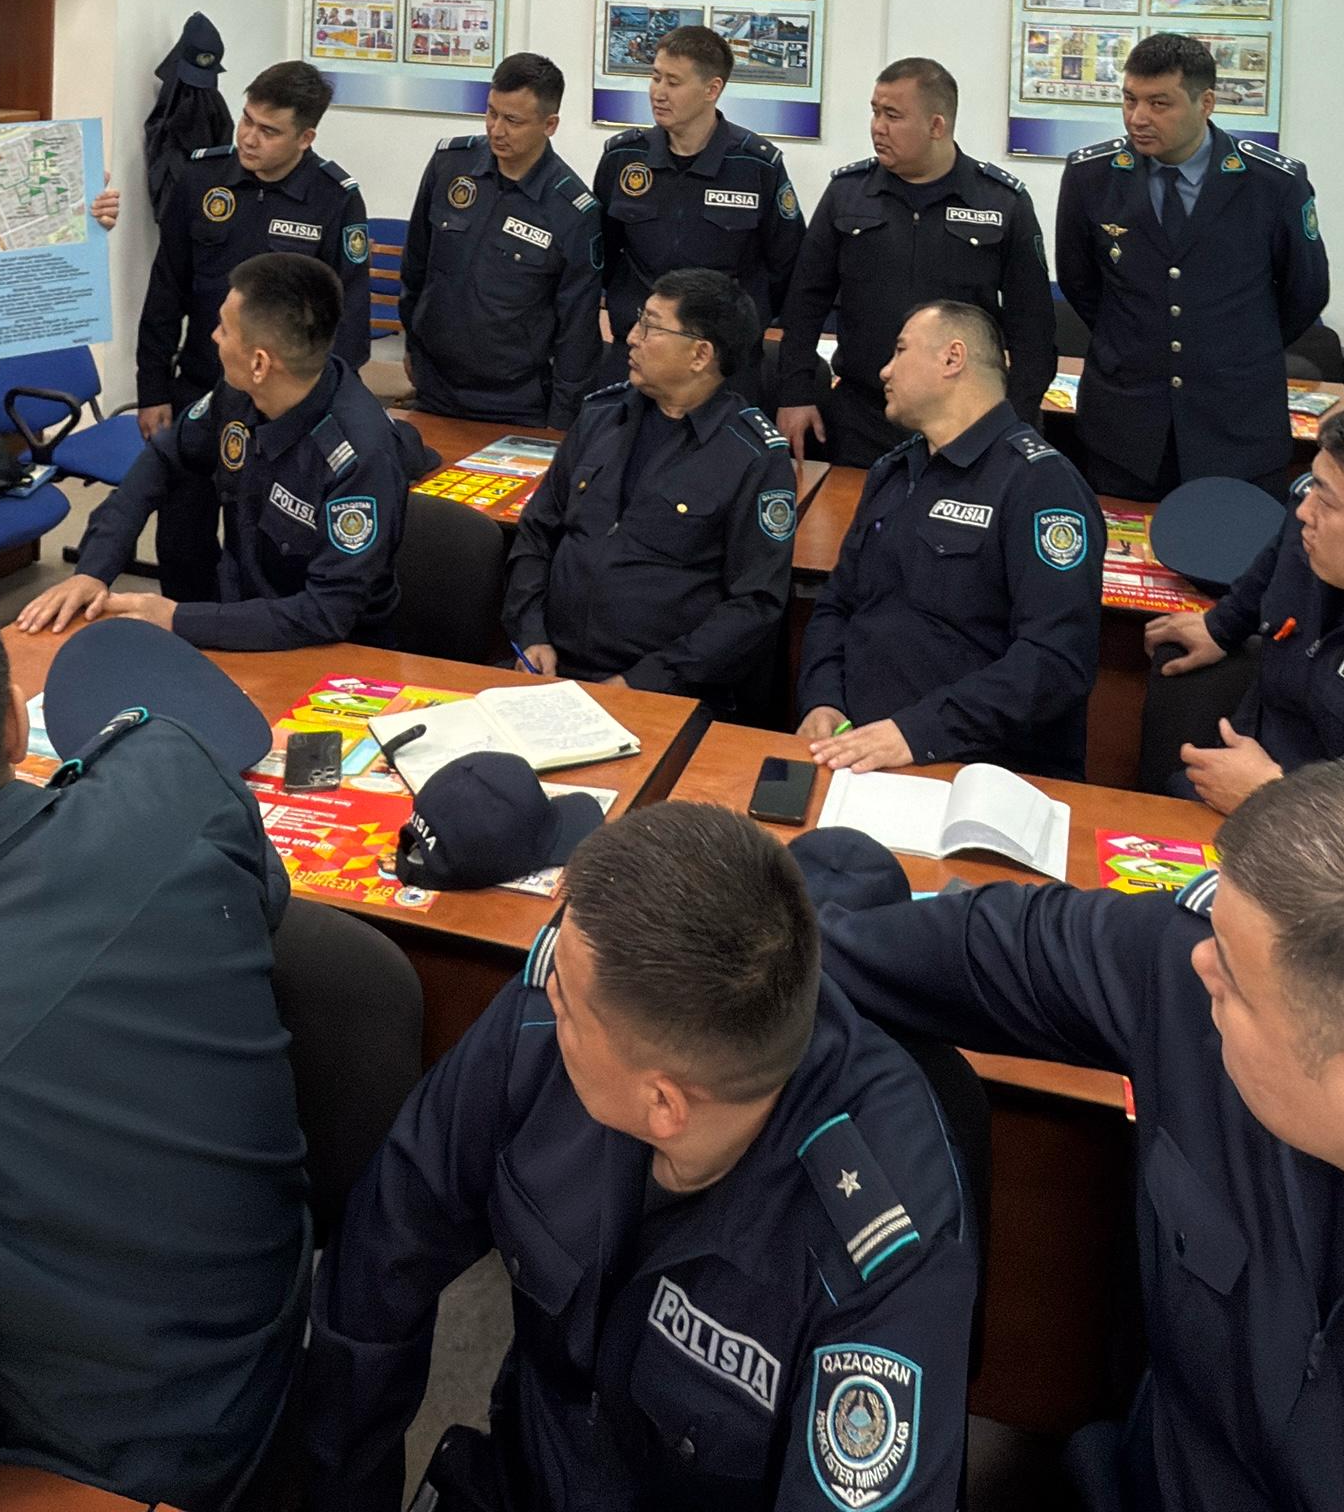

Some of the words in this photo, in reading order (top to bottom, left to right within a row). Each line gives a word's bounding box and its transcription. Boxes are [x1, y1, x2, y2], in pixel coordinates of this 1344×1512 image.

[708, 193, 755, 206] POLISIA
[950, 209, 999, 223] POLISIA
[273, 223, 318, 237] POLISIA
[507, 221, 549, 245] POLISIA
[274, 487, 315, 523] POLISI
[935, 502, 986, 523] POLISIA
[409, 811, 436, 851] LISIA
[659, 1292, 770, 1397] POLISIA
[822, 1352, 911, 1386] QAZAQSTAN
